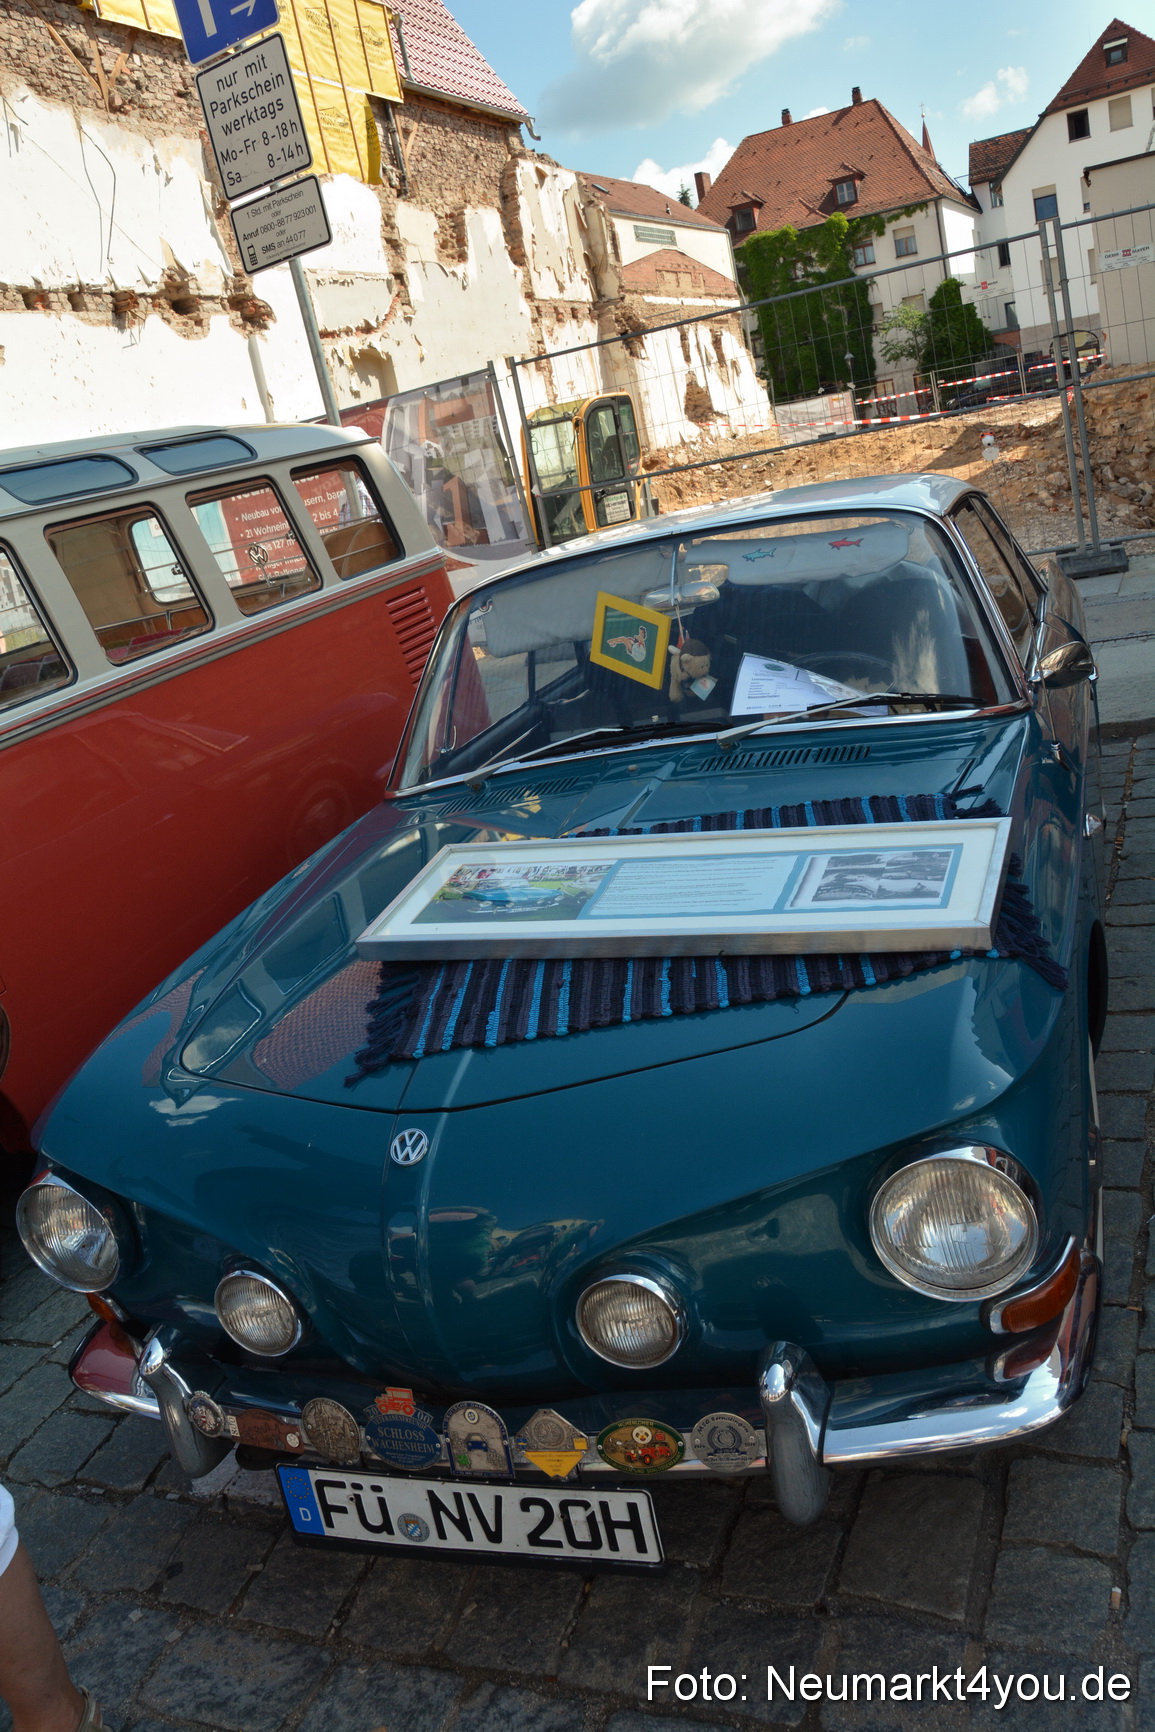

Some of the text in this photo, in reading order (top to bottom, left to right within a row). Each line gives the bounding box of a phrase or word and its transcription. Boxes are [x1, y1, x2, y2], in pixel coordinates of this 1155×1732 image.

[216, 53, 268, 92] nur mit
[209, 72, 285, 119] Parkschein
[221, 97, 284, 137] werktags
[220, 138, 257, 166] Mo-Fr
[226, 172, 242, 186] Sa
[246, 190, 304, 220] 1 Std. mit Parkschein
[270, 209, 282, 218] oder
[242, 228, 260, 242] Anruf
[276, 228, 287, 238] oder
[262, 242, 276, 255] SMS
[276, 240, 286, 248] an
[241, 508, 270, 522] Neubau
[312, 508, 340, 522] 2 bis 4
[272, 539, 285, 550] 127
[391, 1128, 429, 1165] VW
[377, 1426, 426, 1442] SCHLOSS
[372, 1438, 436, 1454] WACHENHEIM
[299, 1507, 312, 1522] D
[314, 1478, 395, 1536] FÜ
[426, 1489, 504, 1544] NV
[519, 1496, 649, 1554] 20H
